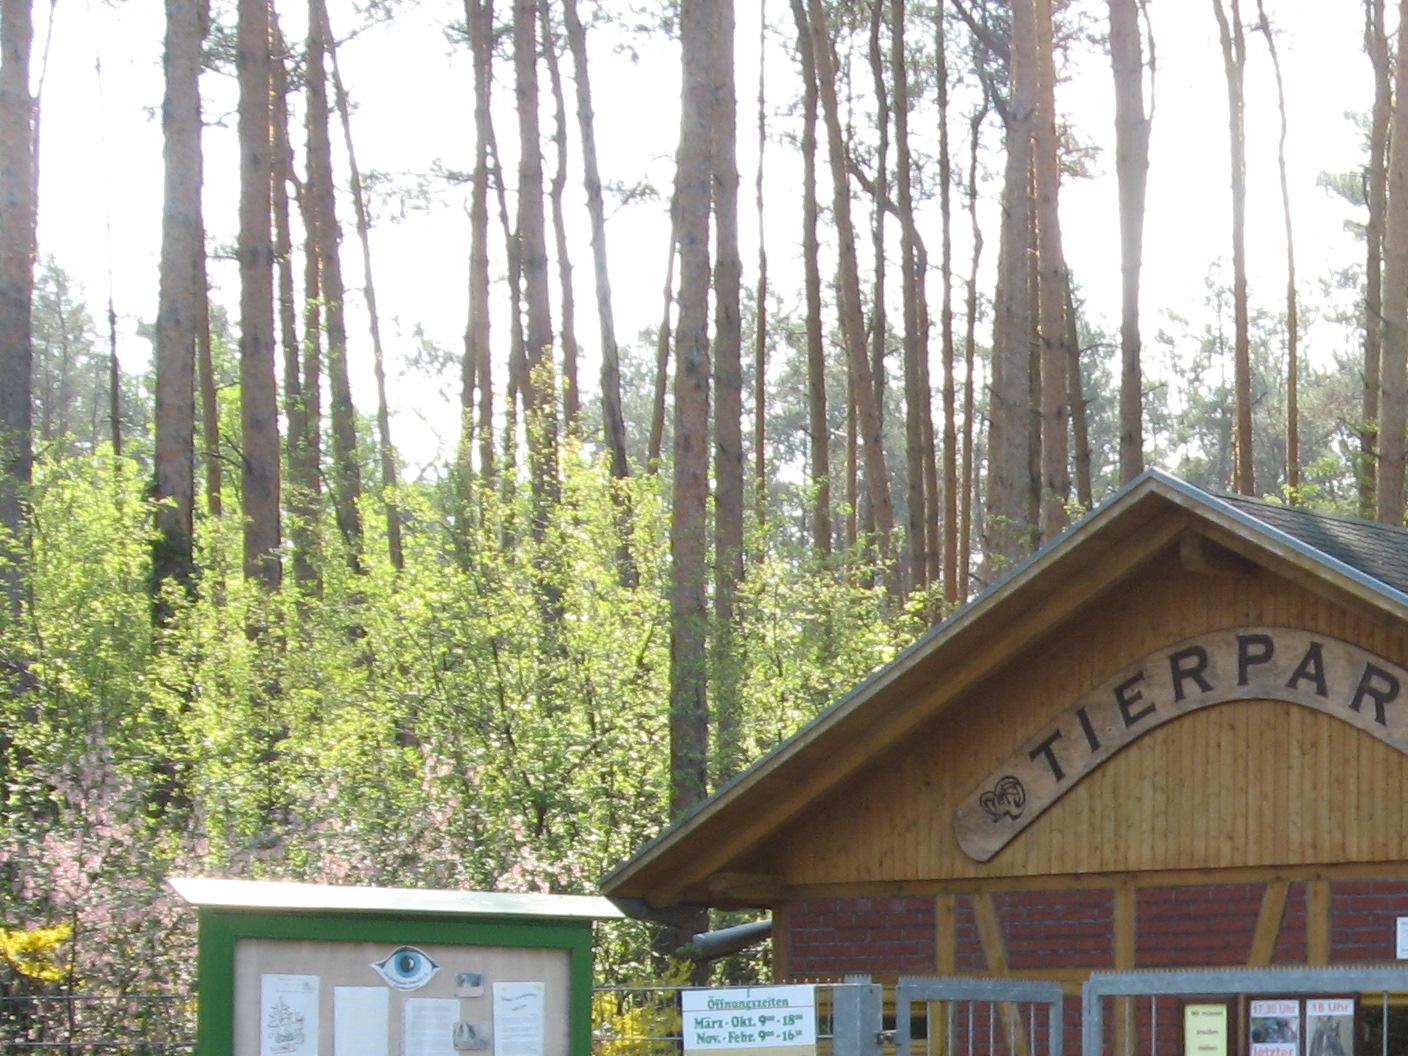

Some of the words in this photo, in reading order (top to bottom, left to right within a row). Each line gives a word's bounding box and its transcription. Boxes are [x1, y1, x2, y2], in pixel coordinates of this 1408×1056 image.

[707, 996, 789, 1010] Öffnungszeiten
[1312, 1002, 1325, 1012] 18
[1328, 1002, 1349, 1012] Uhr
[694, 1015, 723, 1029] März
[731, 1015, 756, 1028] Okt.
[696, 1032, 721, 1044] Nov.
[728, 1031, 756, 1044] Febr.
